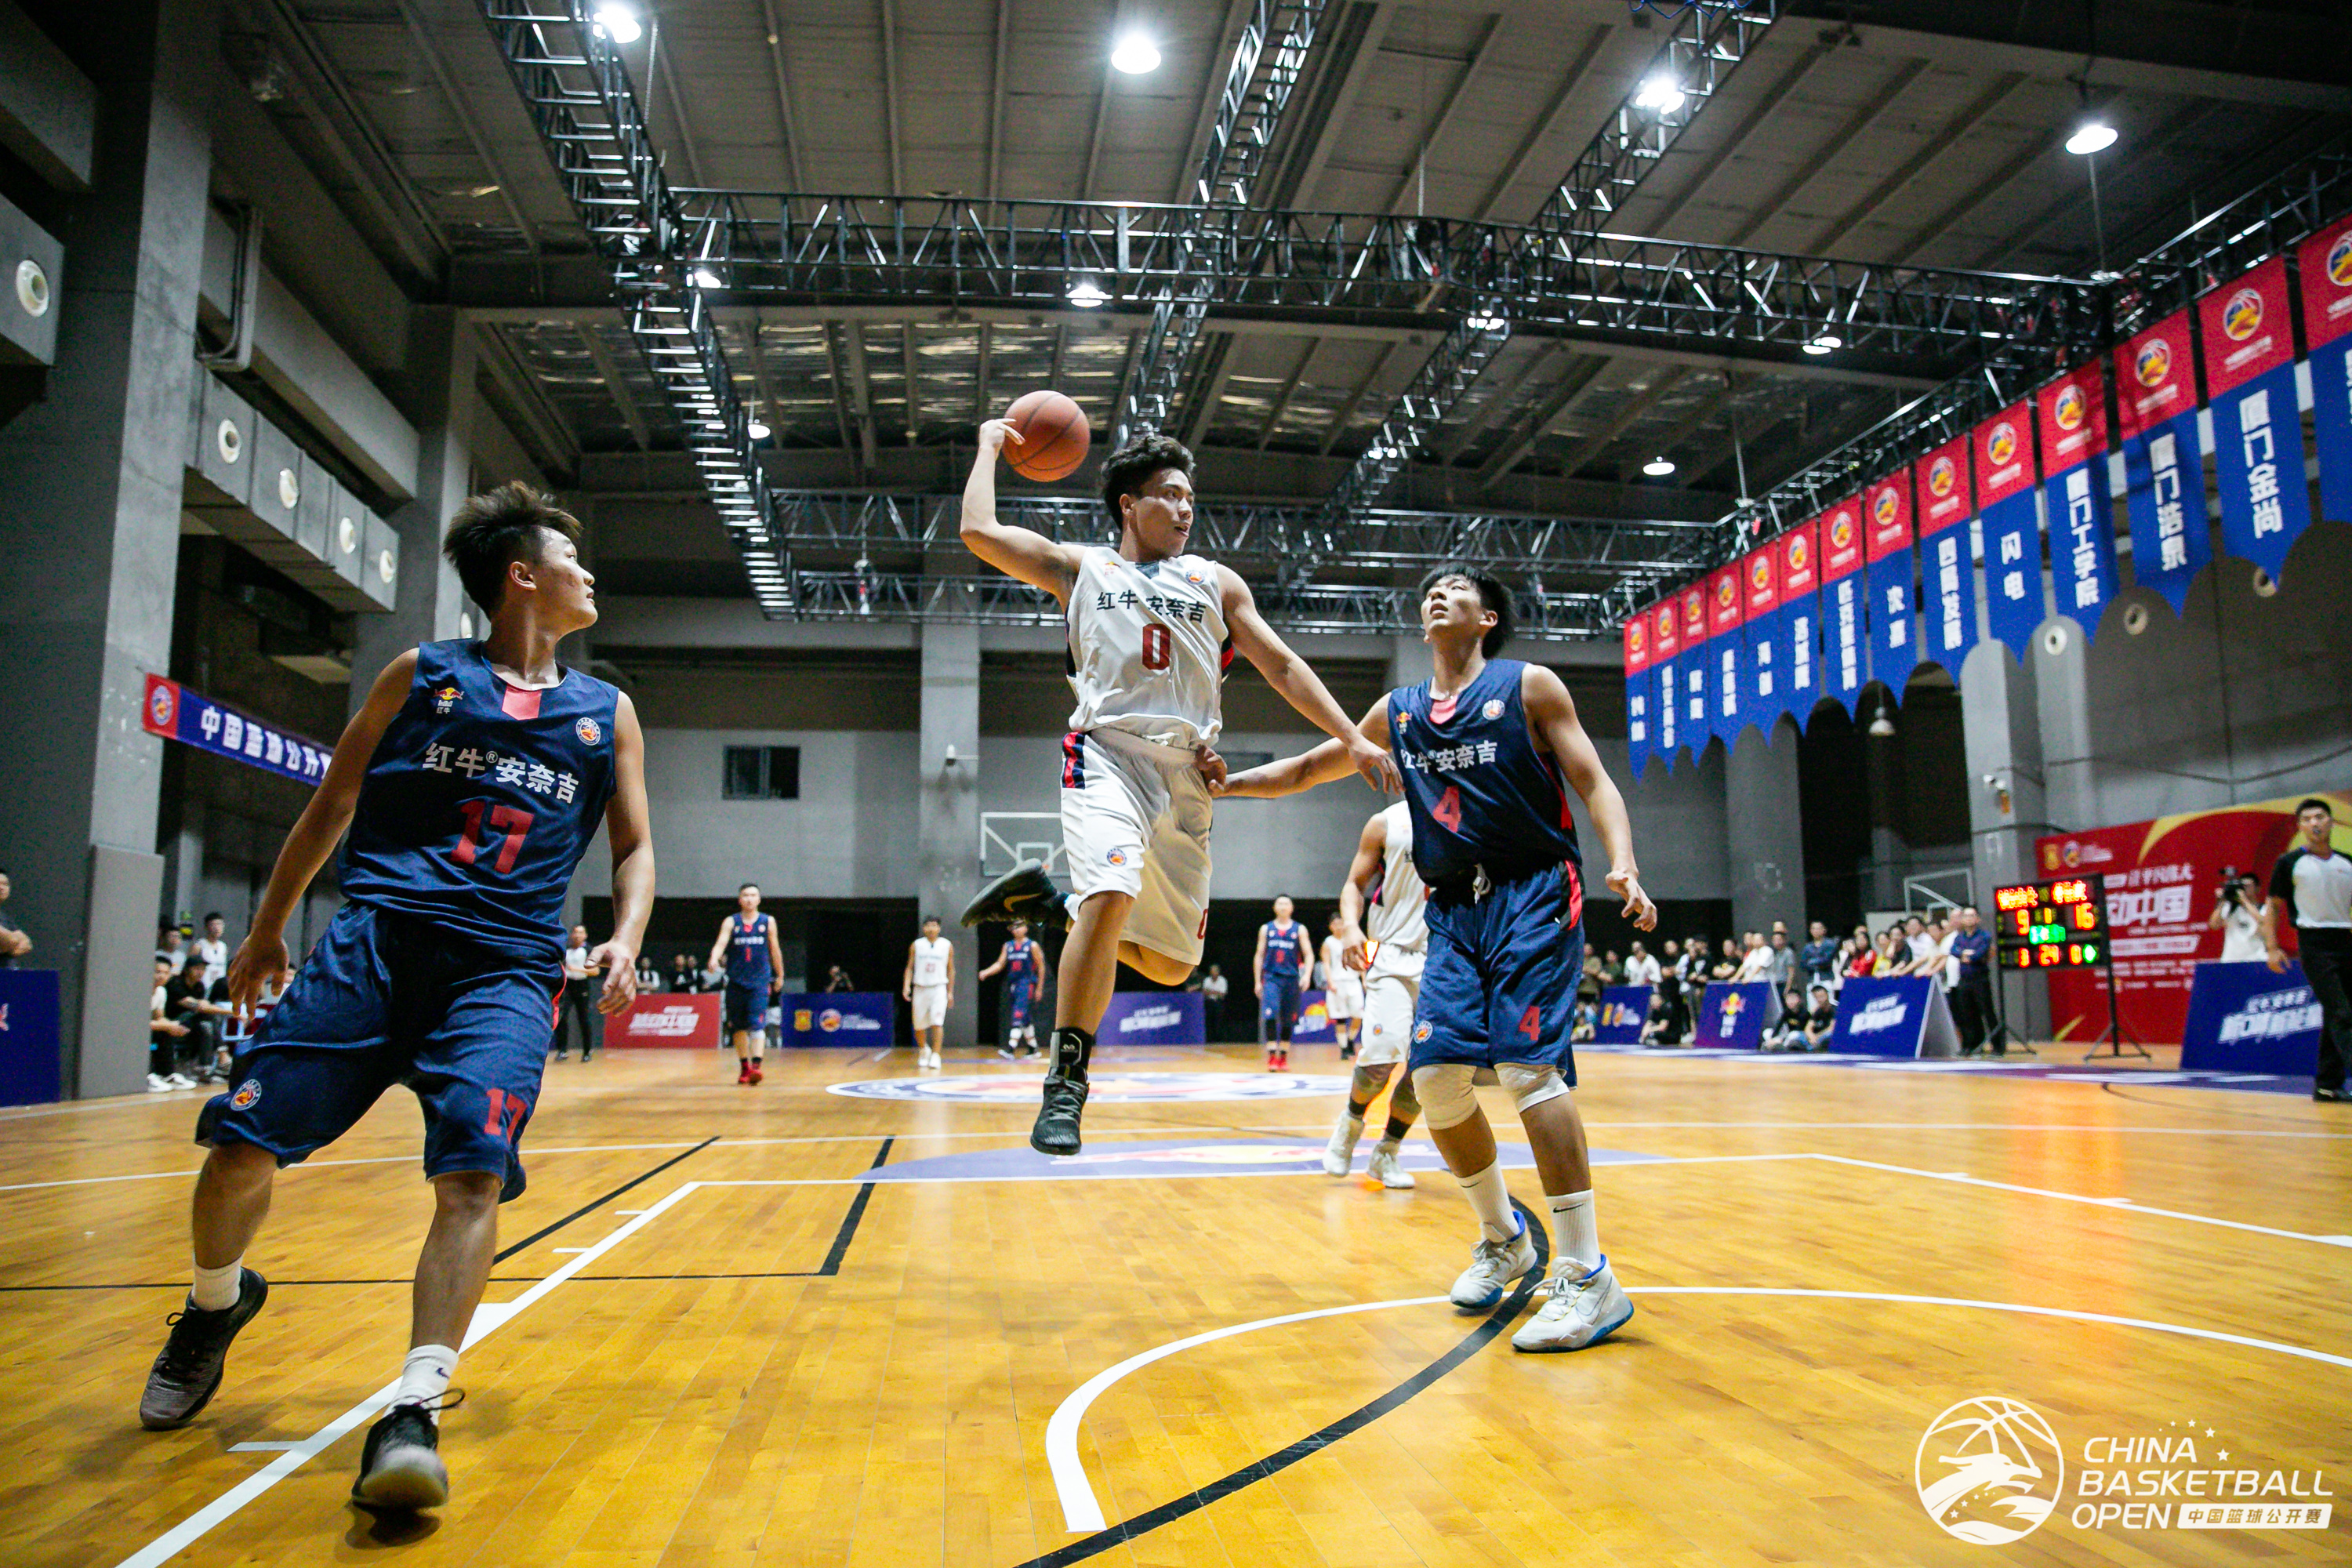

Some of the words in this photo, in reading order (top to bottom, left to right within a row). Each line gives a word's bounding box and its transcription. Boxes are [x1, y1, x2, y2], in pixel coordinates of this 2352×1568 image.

[1142, 623, 1171, 670] 0
[1433, 786, 1461, 833] 4
[450, 800, 535, 875] 17
[2016, 909, 2030, 936] 9
[2074, 902, 2095, 930] 16
[1518, 1005, 1541, 1041] 4
[484, 1087, 528, 1145] 17
